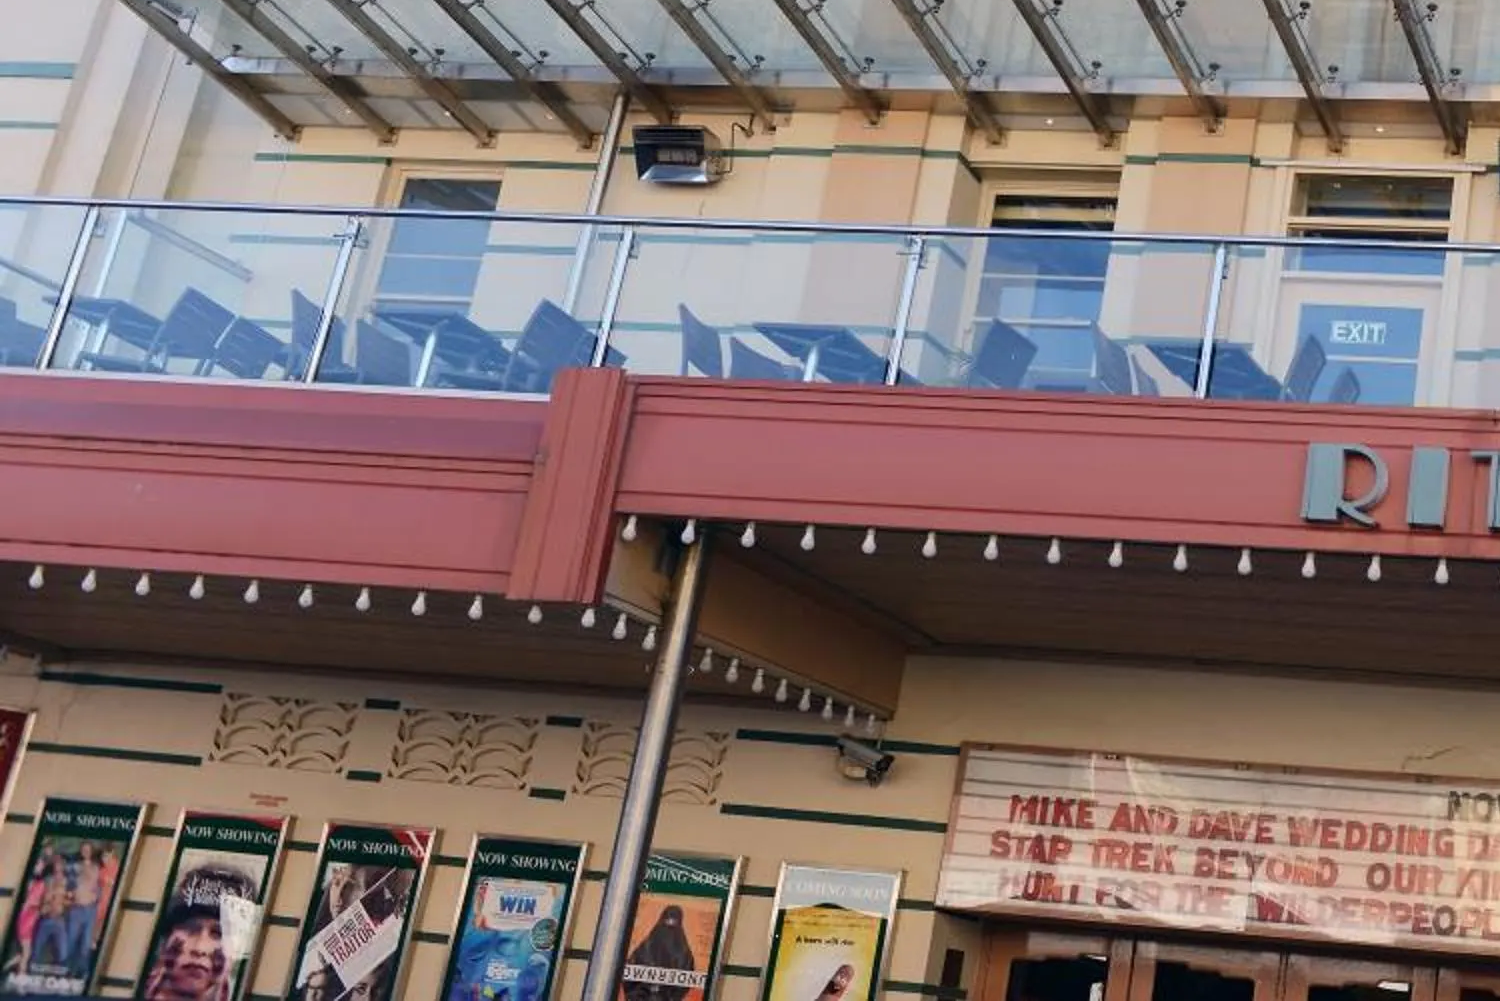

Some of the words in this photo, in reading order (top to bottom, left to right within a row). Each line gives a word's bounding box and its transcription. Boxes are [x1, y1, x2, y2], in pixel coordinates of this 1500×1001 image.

[1331, 321, 1386, 344] EXIT
[44, 811, 73, 824] NOW
[76, 814, 136, 832] SHOWING
[1009, 795, 1097, 830] MIKE
[1109, 803, 1179, 835] AND
[1188, 809, 1277, 844] DAVE
[1288, 816, 1455, 858] WEDDING
[185, 825, 214, 838] NOW
[216, 828, 279, 846] SHOWING
[328, 837, 358, 851] NOW
[477, 851, 509, 865] NOW
[511, 855, 577, 872] SHOWING
[1089, 838, 1180, 874] TREK
[1194, 846, 1339, 889] BEYOND
[1366, 862, 1443, 895] OUR
[499, 894, 537, 916] WIN
[329, 921, 376, 966] TRAITOR
